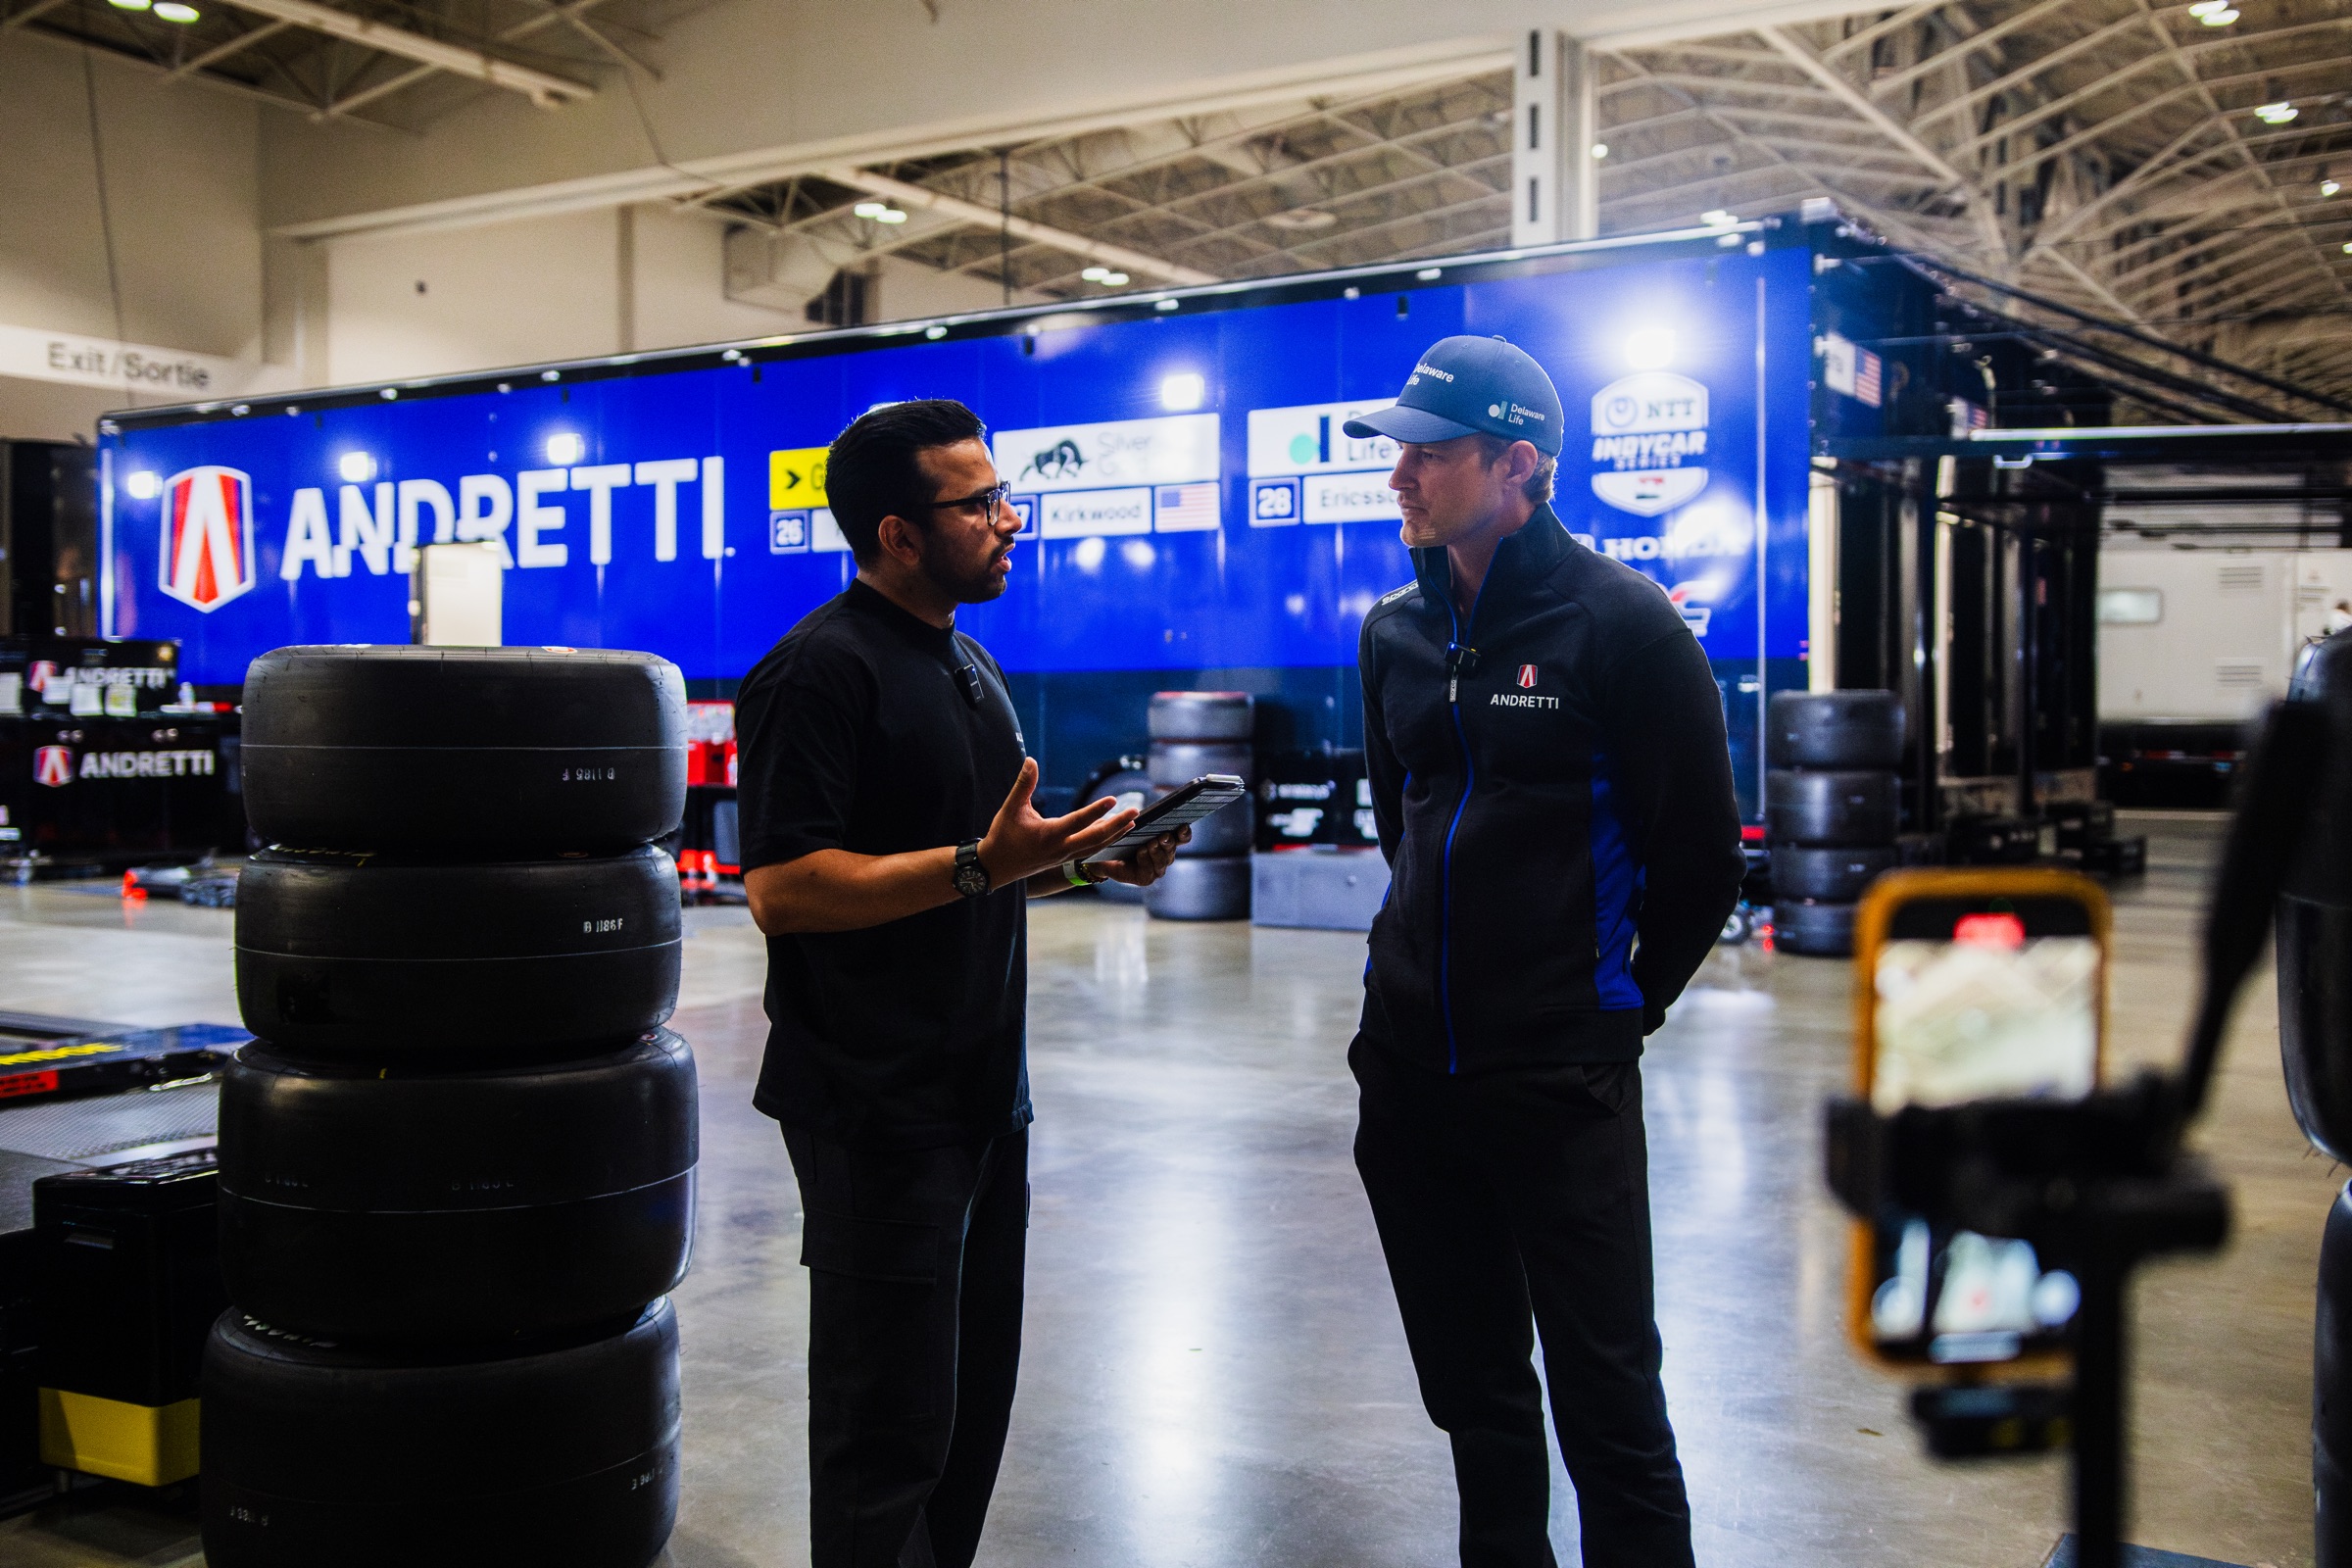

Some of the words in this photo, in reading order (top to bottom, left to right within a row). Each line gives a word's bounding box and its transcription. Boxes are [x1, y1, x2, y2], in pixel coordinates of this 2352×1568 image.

[1510, 403, 1545, 421] Delaware
[1647, 398, 1694, 418] NTT
[1508, 414, 1524, 425] Life
[1348, 440, 1392, 462] Life
[1592, 430, 1707, 462] INDYCAR
[1257, 486, 1293, 518] 28
[1321, 487, 1396, 508] Ericsso
[280, 456, 725, 580] ANDRETTI
[1052, 501, 1141, 523] Kirkwood
[1491, 693, 1559, 710] ANDRETTI
[79, 750, 216, 779] ANDRETTI
